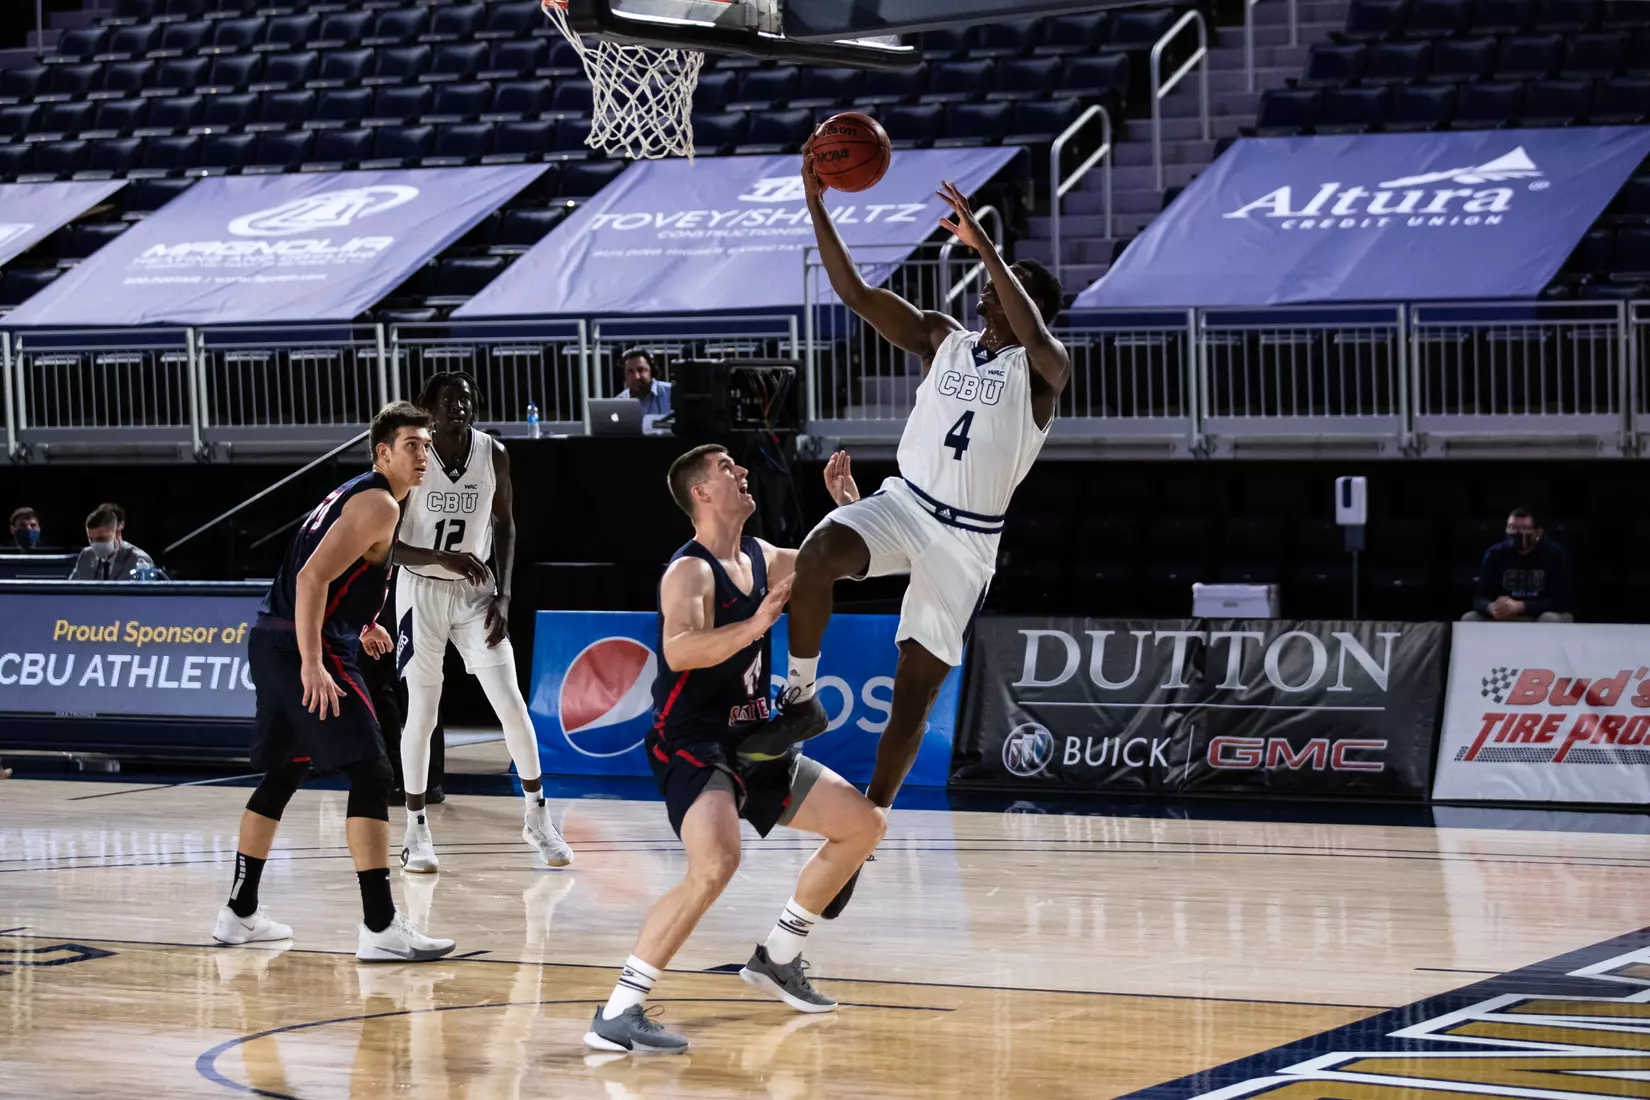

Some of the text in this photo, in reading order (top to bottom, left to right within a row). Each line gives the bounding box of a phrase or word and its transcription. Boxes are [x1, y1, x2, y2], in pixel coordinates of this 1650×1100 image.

[822, 124, 857, 136] ilson
[817, 147, 850, 164] NCAA
[1222, 182, 1514, 218] Altura
[591, 203, 927, 231] TOVEY/SHULTZ
[1281, 215, 1502, 230] CREDIT UNION
[141, 236, 394, 257] MAGNOLIA
[938, 370, 1005, 406] CBU
[987, 369, 1005, 377] WAC
[944, 409, 975, 461] 4
[427, 491, 478, 513] CBU
[433, 518, 466, 553] 12
[53, 619, 248, 647] Proud Sponsor of
[0, 653, 75, 686] CBU
[1011, 629, 1401, 692] DUTTON
[1504, 666, 1650, 708] Bud's
[1062, 736, 1172, 769] BUICK
[1207, 735, 1388, 772] GMC
[1464, 712, 1650, 763] TIRE PRO
